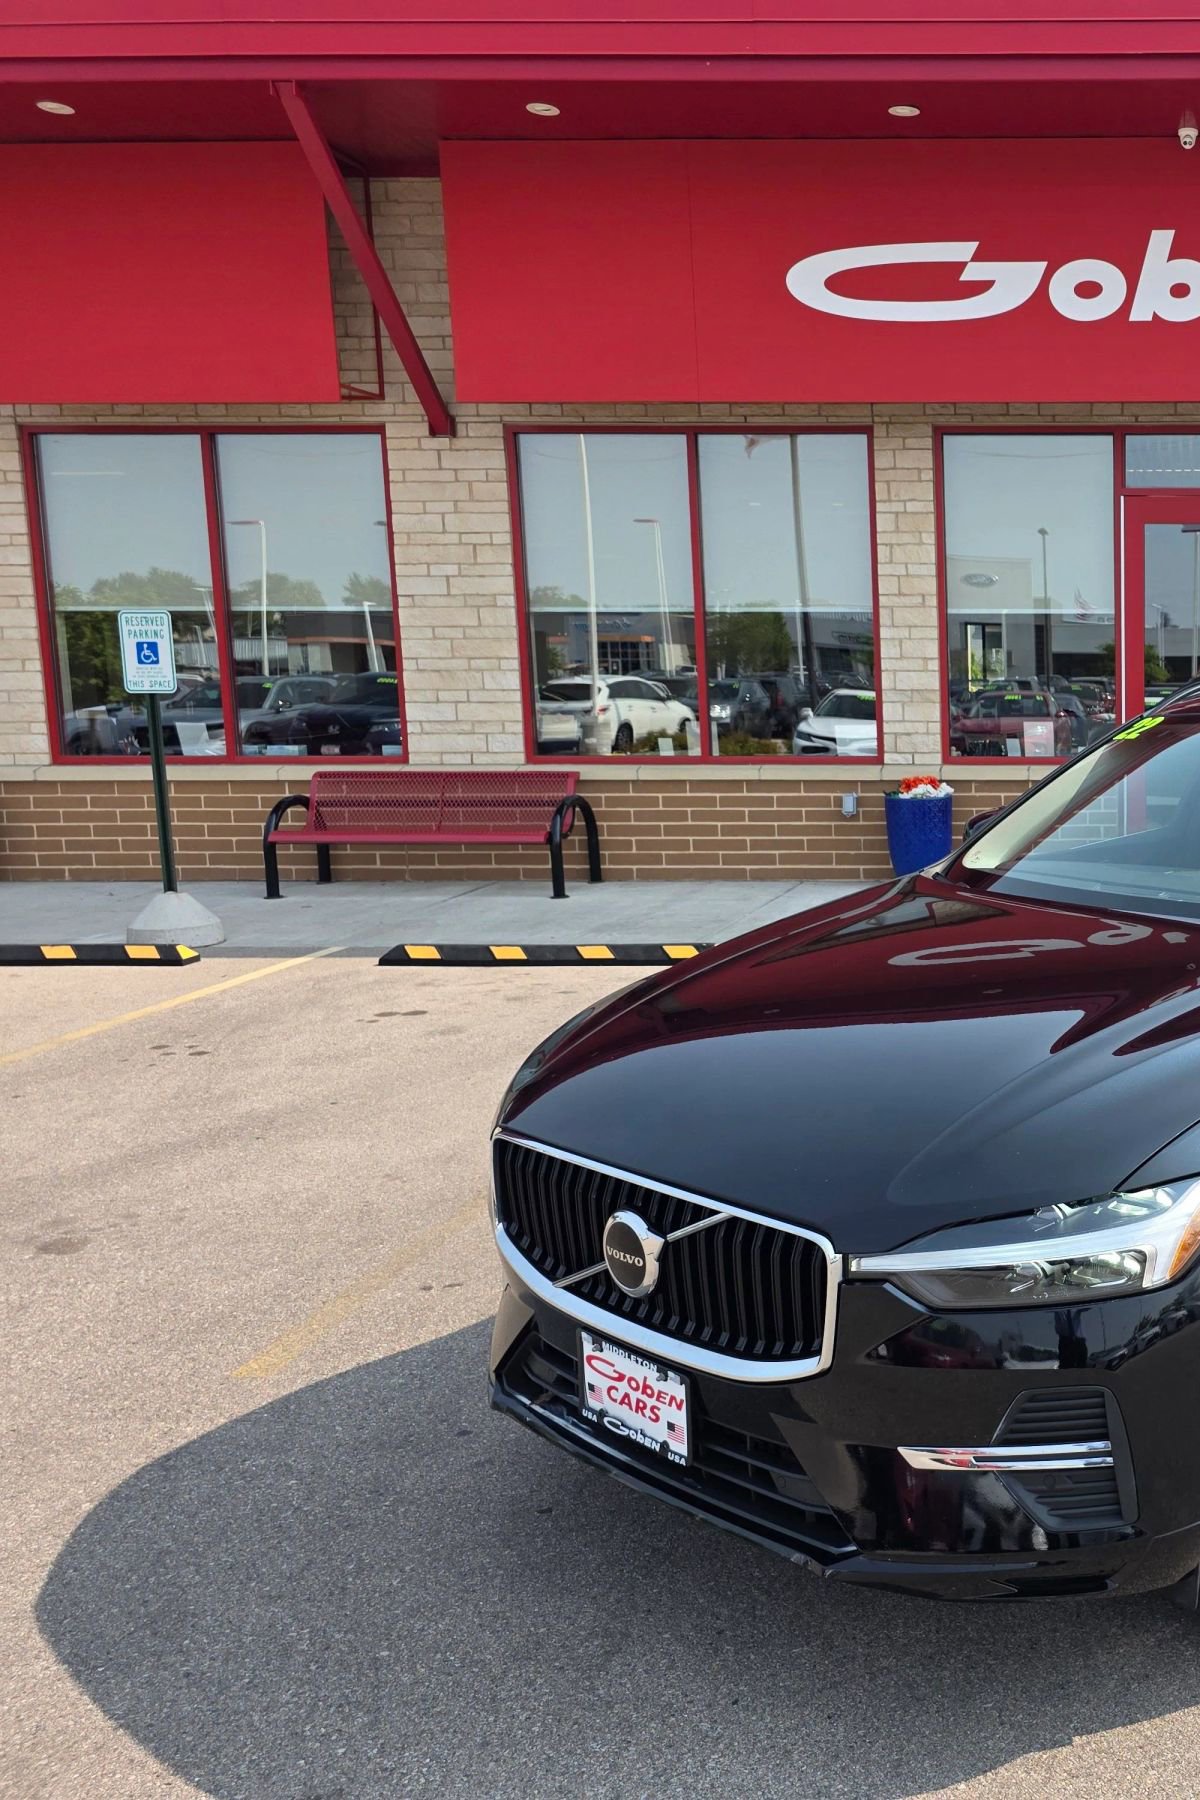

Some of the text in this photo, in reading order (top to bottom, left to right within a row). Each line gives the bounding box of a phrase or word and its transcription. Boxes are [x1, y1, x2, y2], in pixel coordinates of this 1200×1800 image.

[125, 615, 165, 627] RESERVED
[127, 629, 165, 640] PARKING
[128, 680, 172, 689] THIS SPACE
[606, 1245, 644, 1267] VOLVO
[602, 1341, 657, 1373] MIDDLETON
[606, 1385, 661, 1423] CARS
[582, 1408, 598, 1422] USA
[667, 1451, 687, 1466] USA
